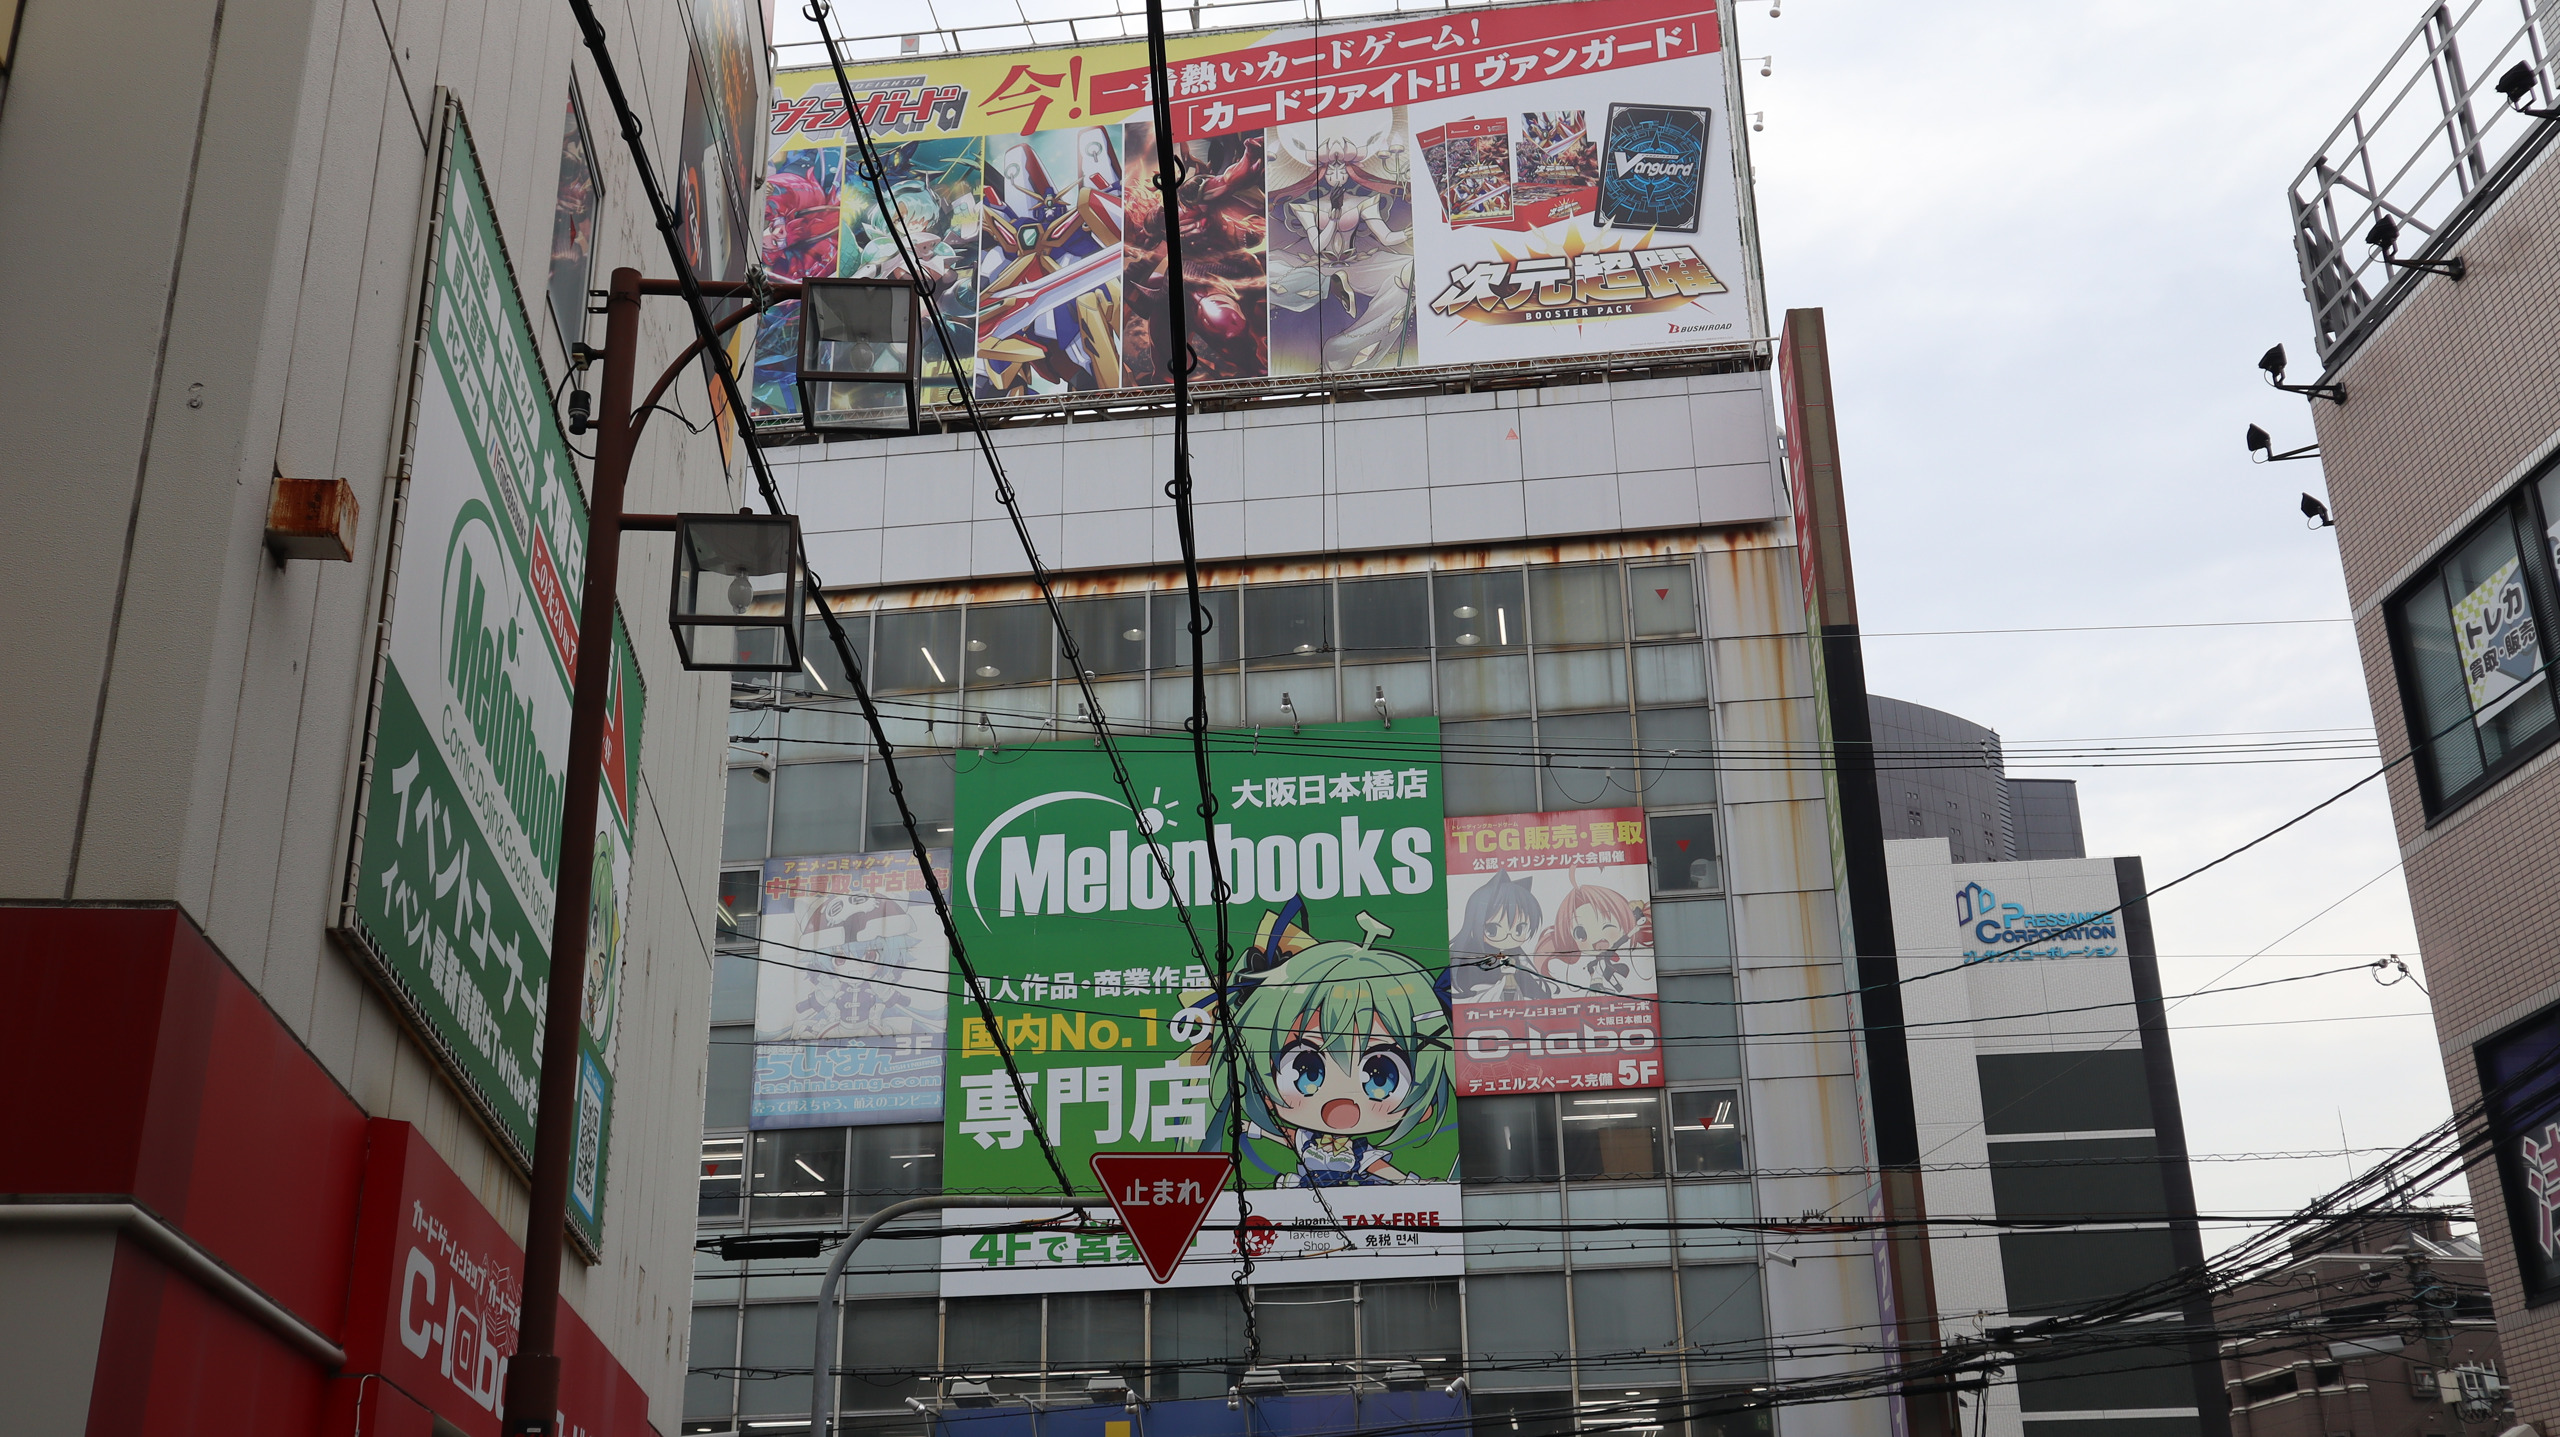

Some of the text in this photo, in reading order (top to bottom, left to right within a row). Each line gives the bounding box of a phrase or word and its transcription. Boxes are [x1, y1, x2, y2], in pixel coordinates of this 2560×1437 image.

[824, 78, 921, 92] CADFIGHT!!
[979, 56, 1082, 136] 今!
[1614, 152, 1694, 178] Vanguard
[1431, 247, 1728, 315] 次元超躍
[1525, 304, 1634, 321] BOOSTER PACK
[1680, 323, 1733, 333] BUSHIROAD
[505, 333, 534, 425] コミック
[2465, 586, 2523, 650] トレカ
[2469, 618, 2536, 684] 買取・販売
[448, 541, 566, 893] Melonbook
[1231, 768, 1428, 810] 大阪日本橋店
[1000, 816, 1433, 917] Melonbooks
[1472, 851, 1625, 870] 公認・オリジナル大会開催
[766, 868, 950, 899] 中古買取・中古販売
[2002, 903, 2115, 928] PRESSANCE
[1975, 919, 2117, 943] CORPORATION
[1467, 1001, 1651, 1020] カードゲームショップ カードラボ
[1597, 1015, 1652, 1026] 大阪日本橋店
[895, 1036, 934, 1056] 3F
[756, 1040, 892, 1082] らしんばん
[1618, 1059, 1659, 1086] 5F
[754, 1075, 942, 1095] lashinbang.com
[1468, 1072, 1613, 1092] デュエルスペース完備
[958, 1060, 1211, 1150] 専門店
[1122, 1178, 1204, 1205] 止まれ
[1343, 1211, 1440, 1227] TAX-FREE
[413, 1199, 488, 1297] カードゲームショップ
[1303, 1241, 1331, 1252] Shop
[1365, 1234, 1391, 1247] 免税
